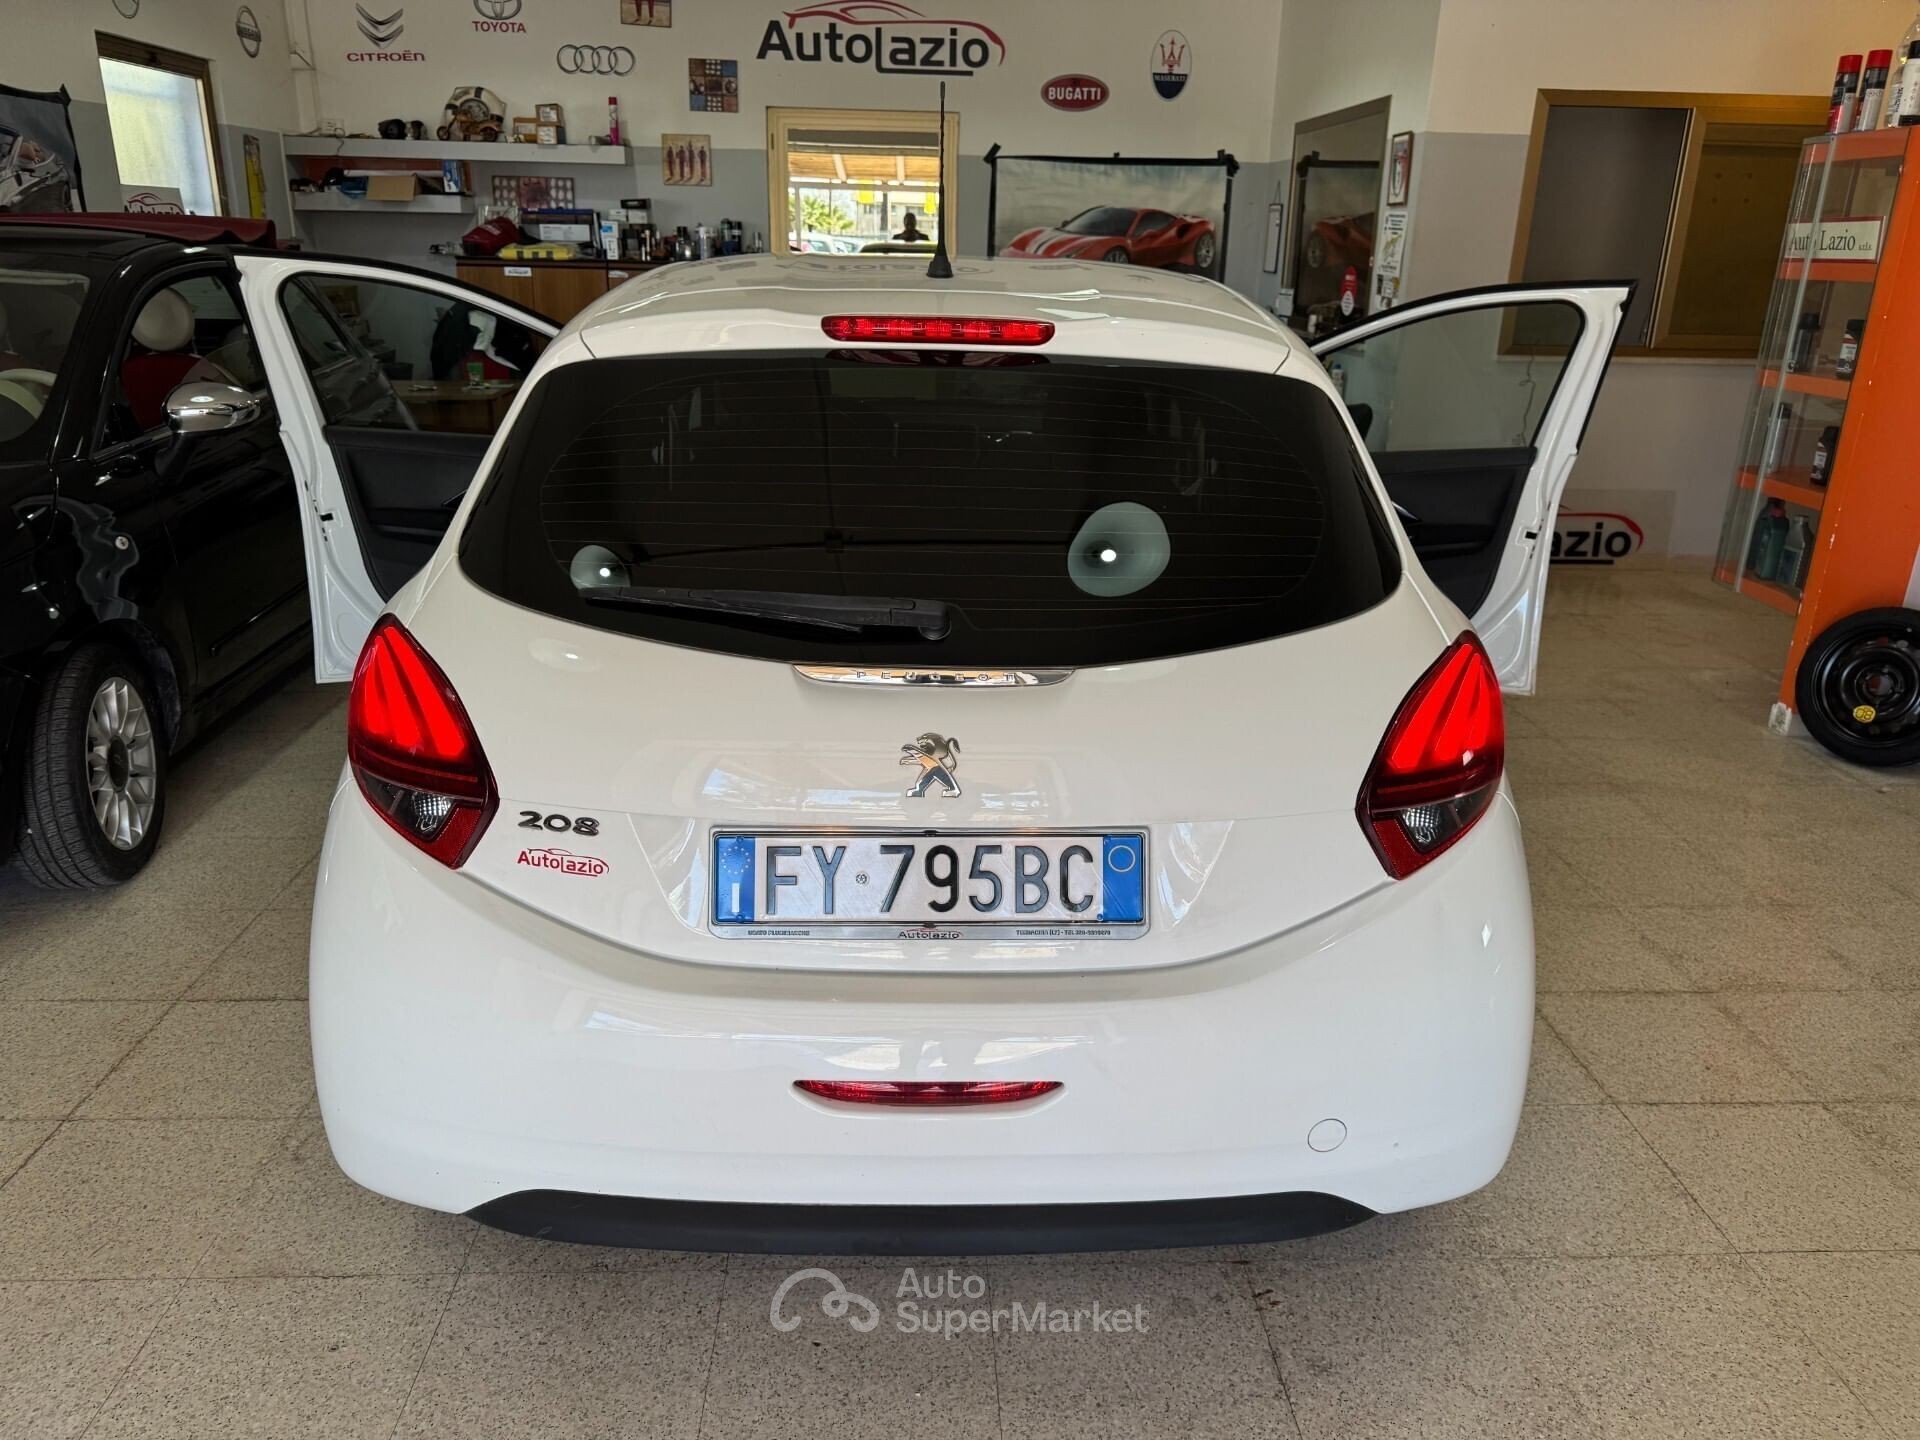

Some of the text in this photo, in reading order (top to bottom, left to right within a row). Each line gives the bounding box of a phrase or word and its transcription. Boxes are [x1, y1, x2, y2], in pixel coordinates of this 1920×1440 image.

[472, 21, 526, 33] TOYOTA
[756, 20, 990, 77] AutoLazio
[1048, 87, 1101, 100] BUGATTI
[1819, 228, 1856, 251] Lazio
[856, 671, 1016, 682] PEUGEOT
[518, 810, 600, 836] 208
[766, 844, 1094, 915] FY 795BC
